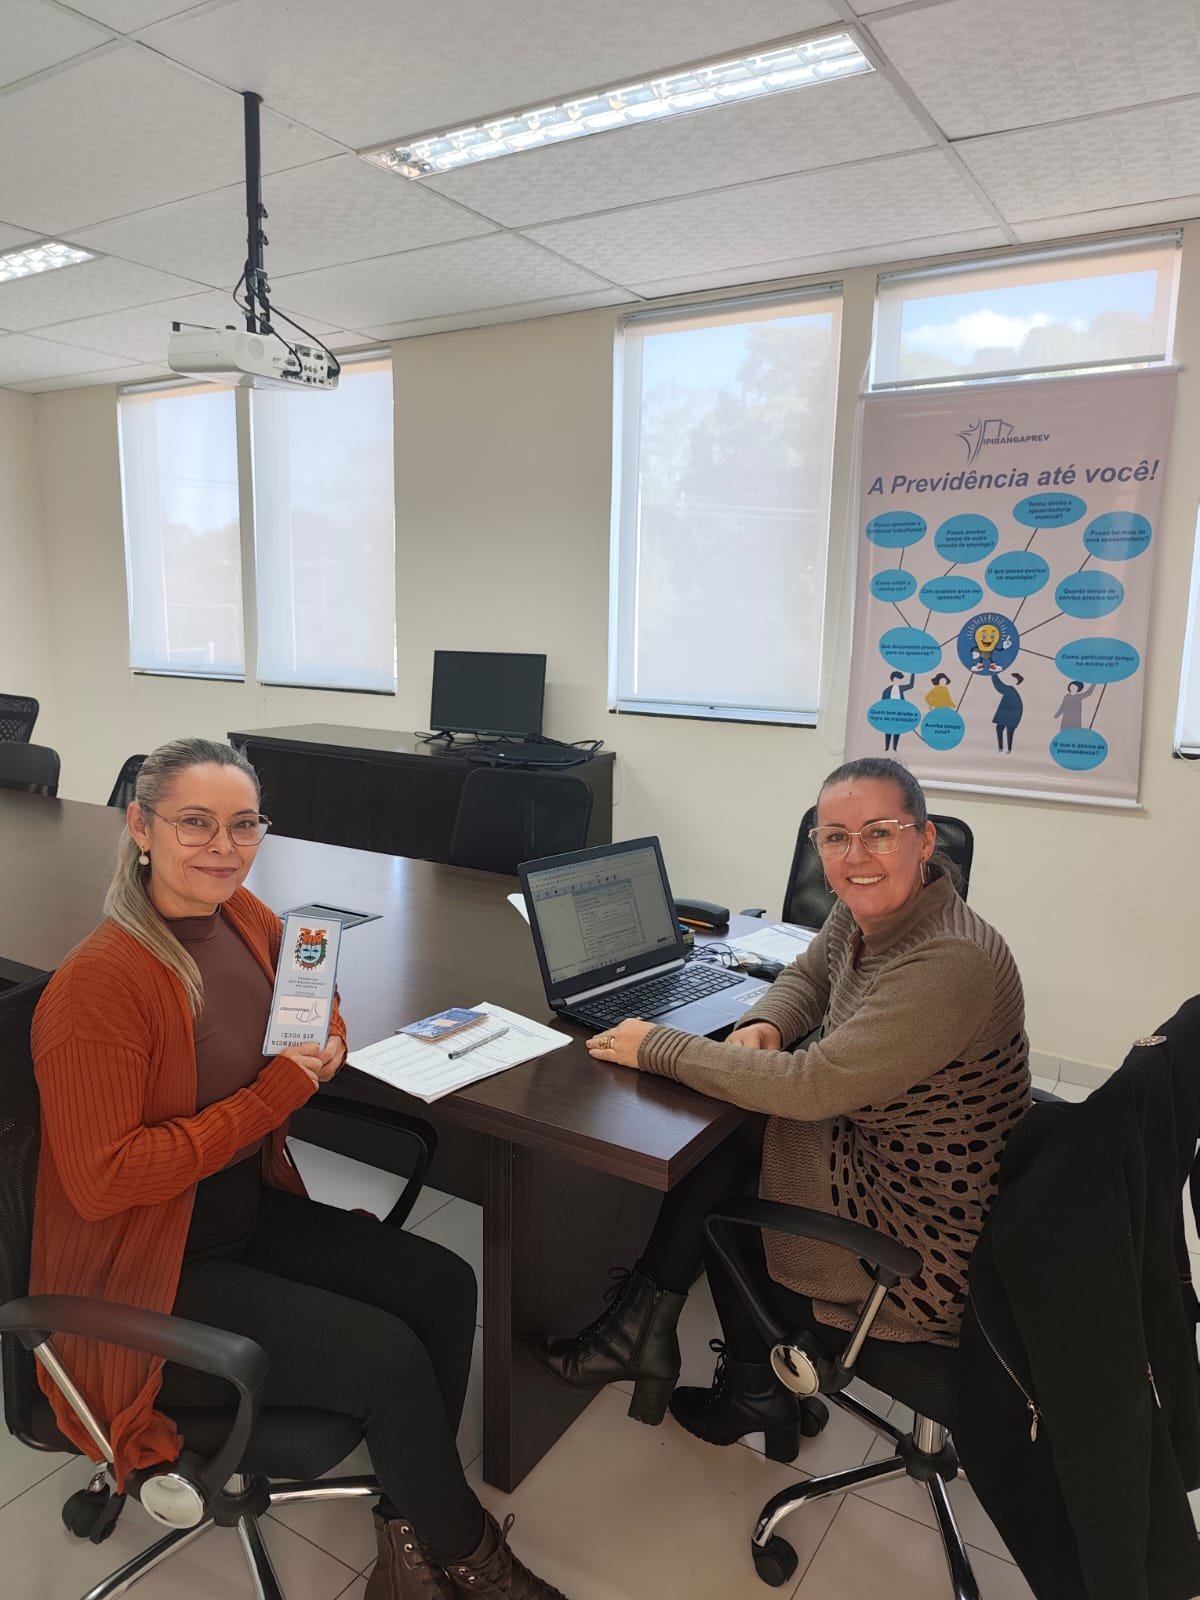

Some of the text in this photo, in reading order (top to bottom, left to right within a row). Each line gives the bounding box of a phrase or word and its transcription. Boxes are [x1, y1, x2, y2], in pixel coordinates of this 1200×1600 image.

[983, 433, 1050, 445] IPIRANGAPREV
[867, 459, 1160, 495] A Previdência até você!
